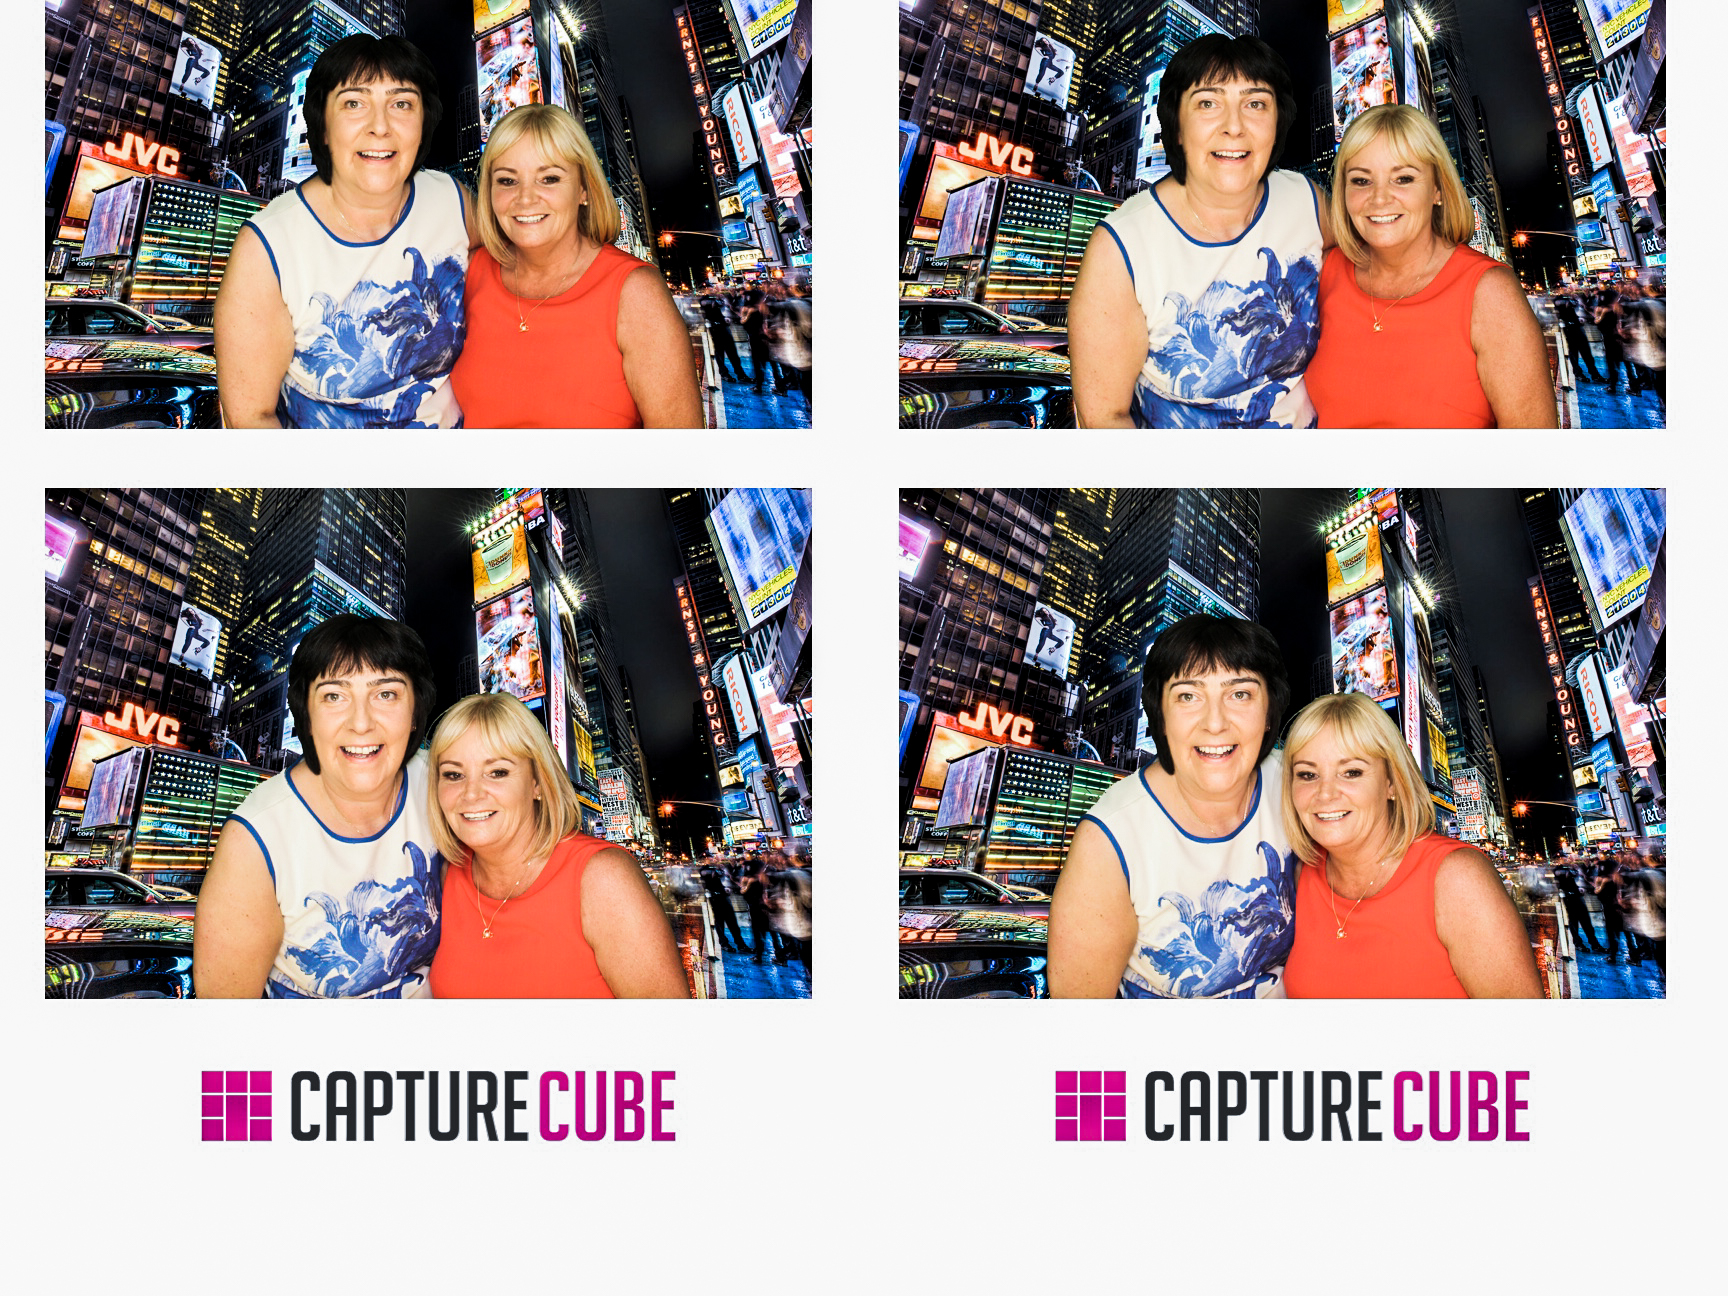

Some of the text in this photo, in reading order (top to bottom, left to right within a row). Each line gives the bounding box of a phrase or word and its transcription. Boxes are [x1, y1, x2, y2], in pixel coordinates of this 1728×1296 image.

[748, 20, 761, 33] NYC
[750, 19, 773, 37] COUNT
[1602, 20, 1615, 33] NYC
[1604, 19, 1627, 37] COUNT
[677, 15, 725, 176] ERNST & YOUNG
[1531, 15, 1579, 176] ERNST & YOUNG
[726, 97, 748, 162] RICOH
[1580, 97, 1602, 162] RICOH
[104, 131, 181, 176] JVC
[958, 131, 1035, 176] JVC
[748, 566, 794, 603] NYC VEHICLES
[750, 589, 773, 607] COUNT
[1602, 566, 1648, 603] NYC VEHICLES
[1604, 589, 1627, 607] COUNT
[677, 585, 725, 746] ERNST & YOUNG
[1531, 585, 1579, 746] ERNST & YOUNG
[726, 667, 748, 732] RICOH
[1580, 667, 1602, 732] RICOH
[104, 701, 181, 746] JVC
[958, 701, 1035, 746] JVC
